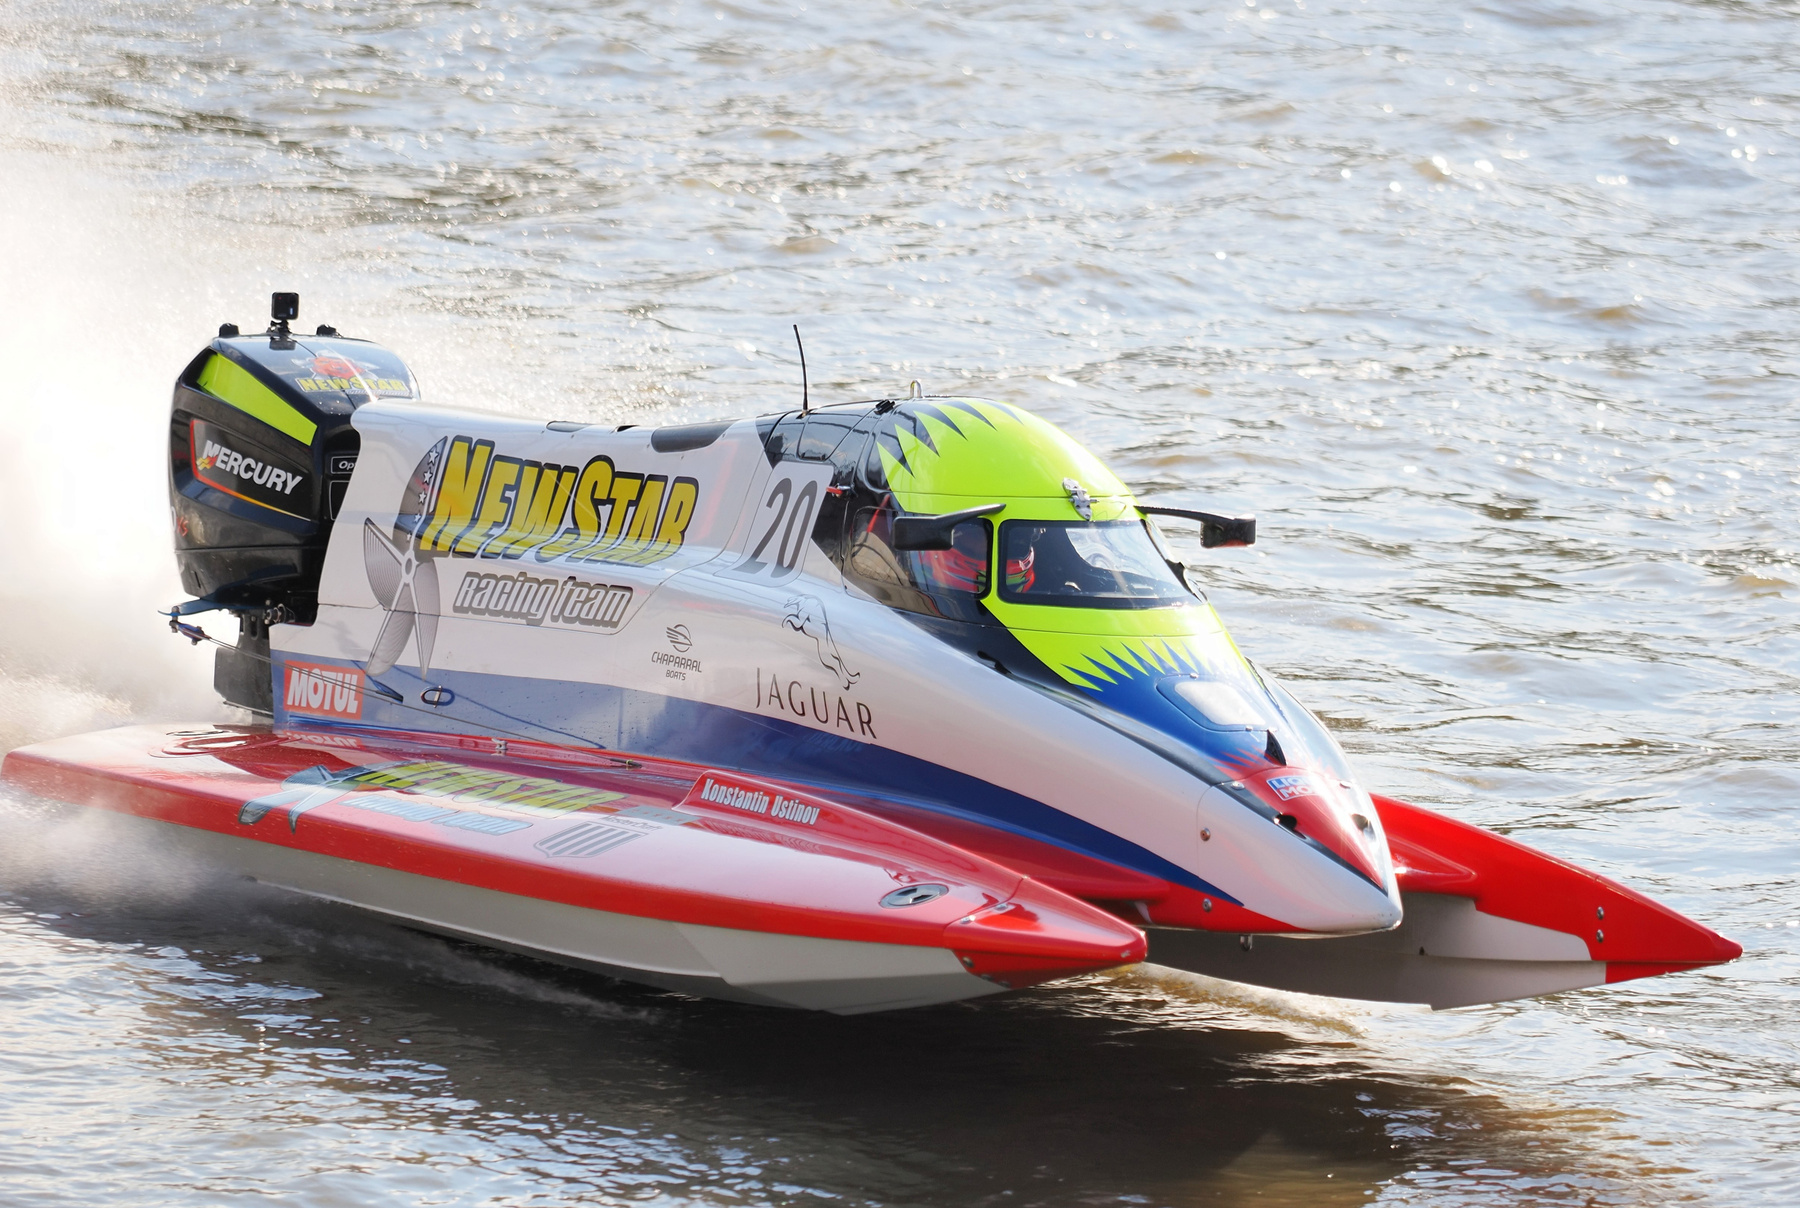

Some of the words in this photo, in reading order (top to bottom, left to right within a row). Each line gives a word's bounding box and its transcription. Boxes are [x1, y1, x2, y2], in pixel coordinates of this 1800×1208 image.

[202, 439, 303, 495] MERCURY
[732, 477, 818, 579] 20
[651, 651, 703, 674] CHAPARRAL
[665, 671, 686, 682] BOATS
[286, 667, 359, 714] MOTUL
[755, 667, 878, 739] JAGUAR
[700, 778, 770, 814] Konstantin
[770, 795, 821, 826] Ustinov
